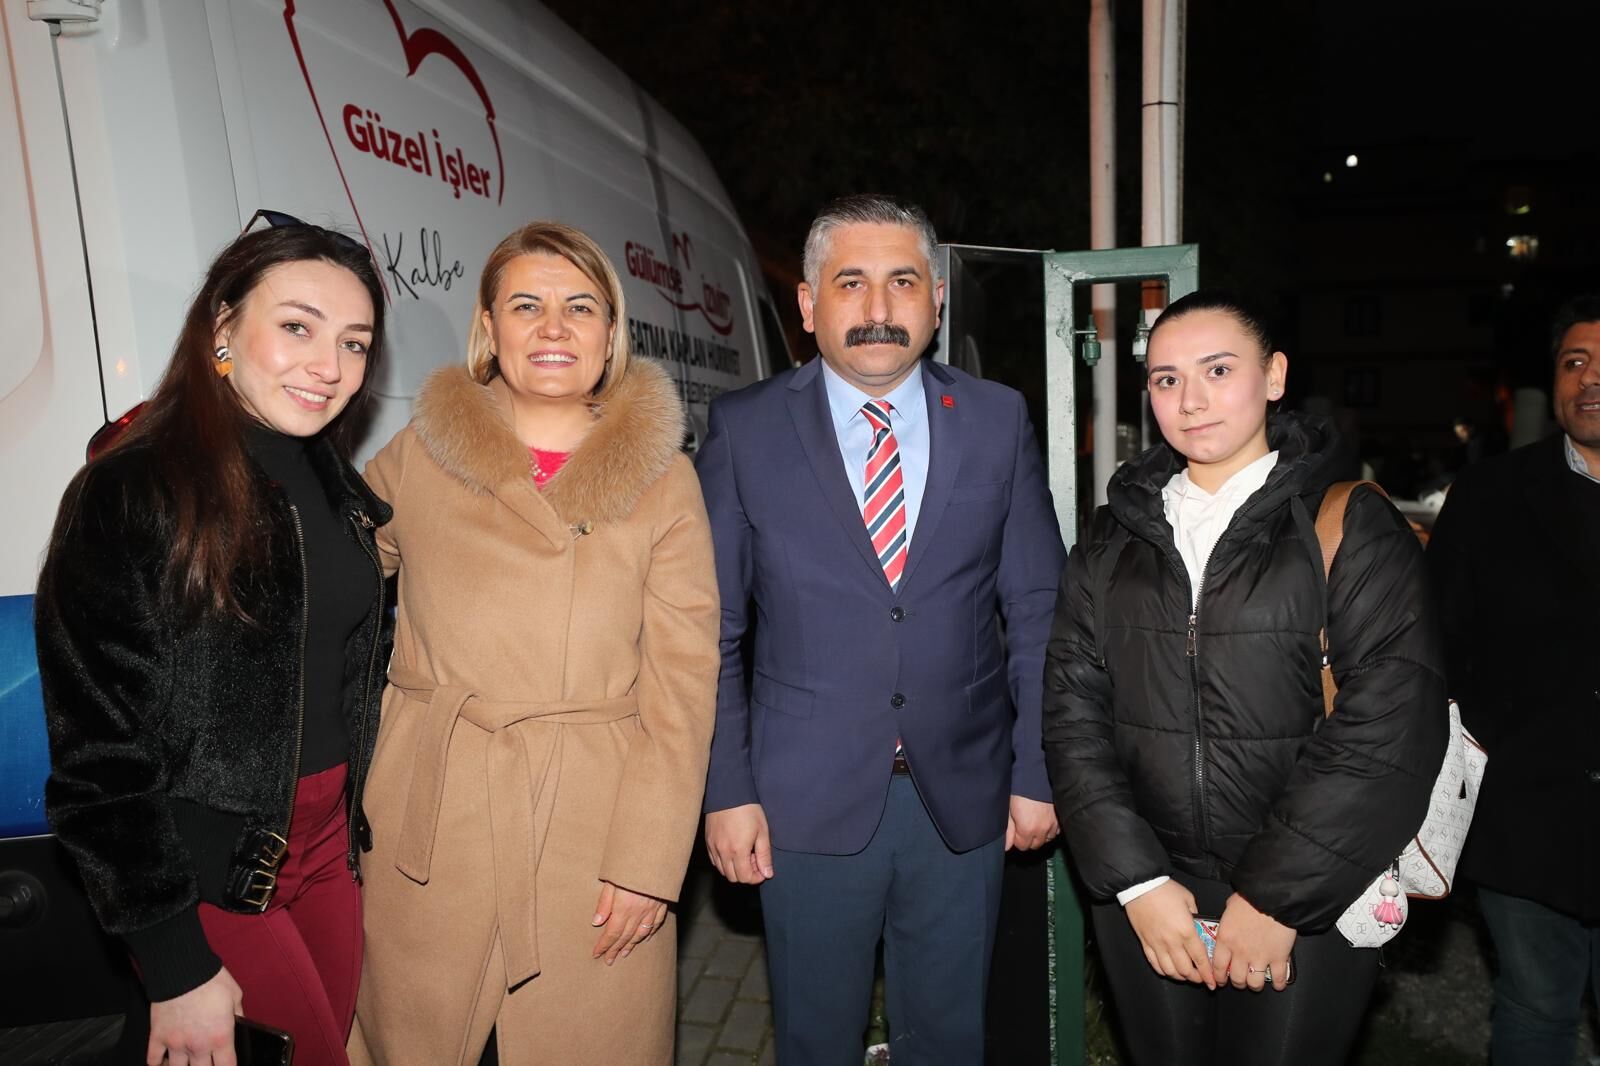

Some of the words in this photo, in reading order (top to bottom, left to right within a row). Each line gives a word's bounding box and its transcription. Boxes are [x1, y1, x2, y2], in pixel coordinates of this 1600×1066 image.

[342, 103, 432, 177] Güzel
[432, 128, 491, 199] İşler
[382, 227, 465, 300] Kalbe
[624, 240, 683, 295] Gülümse
[628, 317, 669, 360] FATMA
